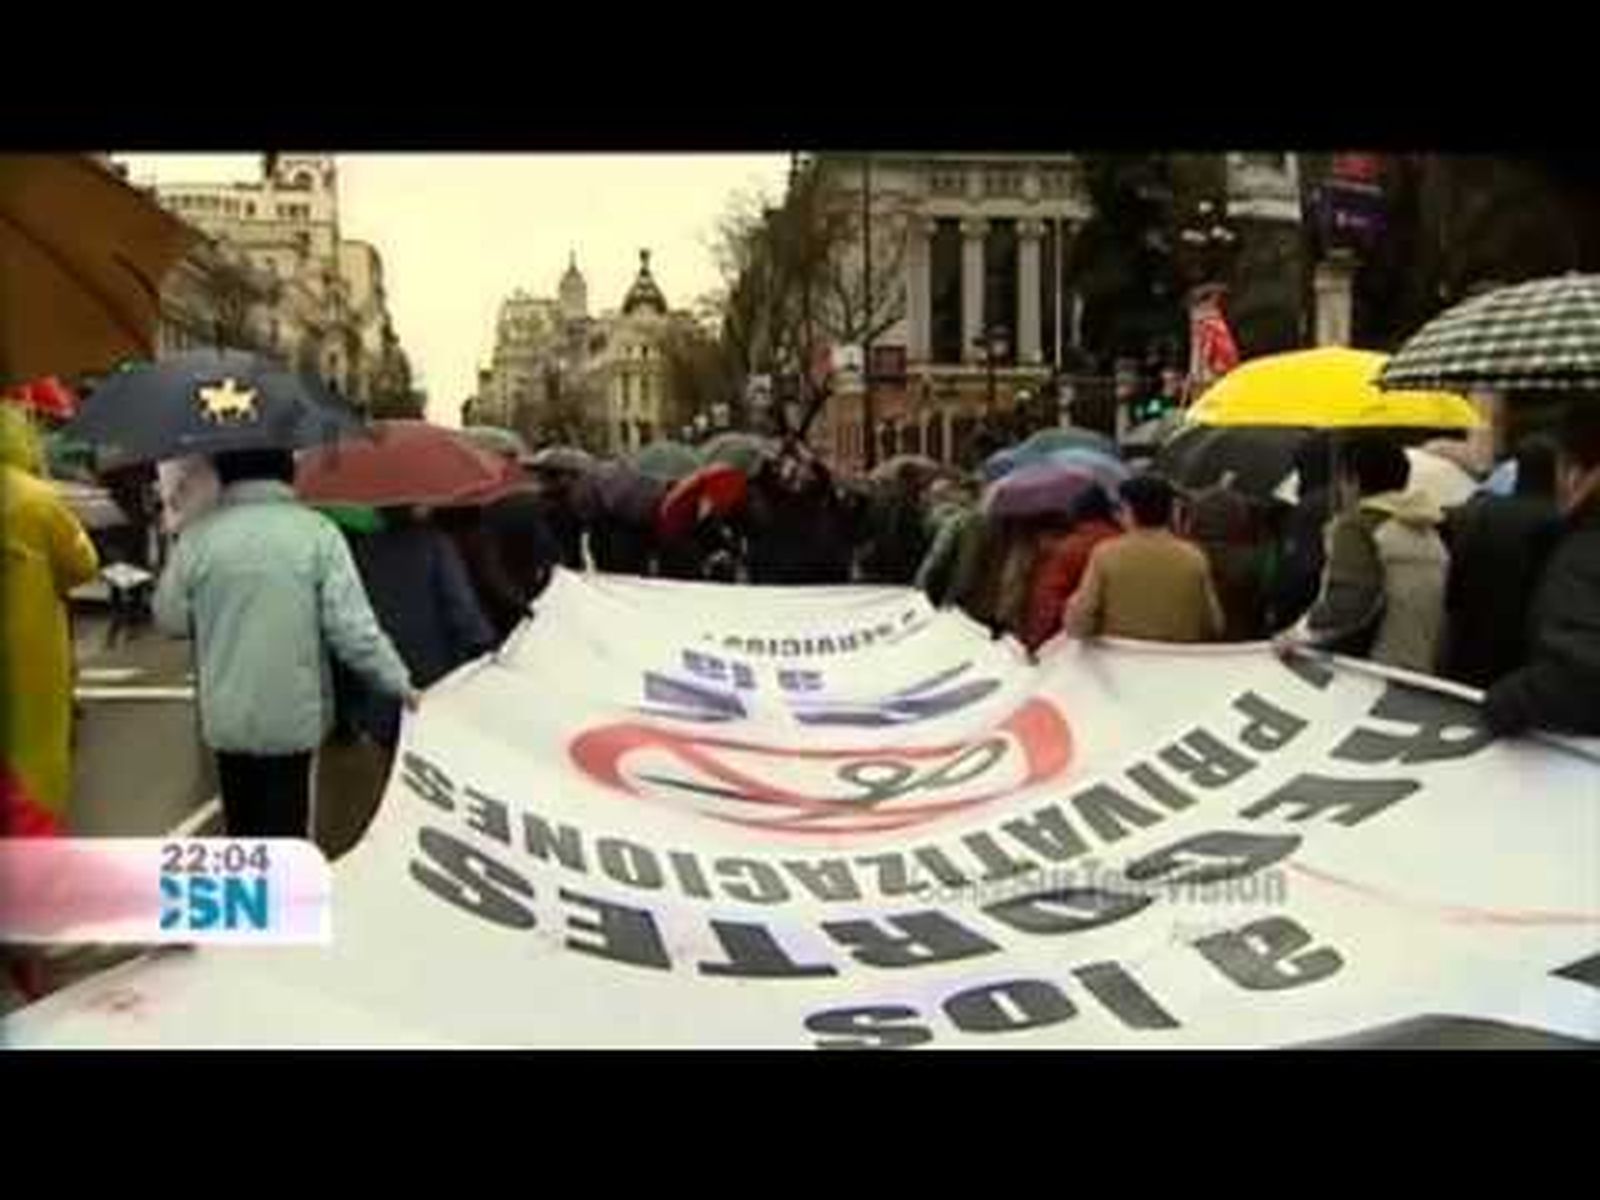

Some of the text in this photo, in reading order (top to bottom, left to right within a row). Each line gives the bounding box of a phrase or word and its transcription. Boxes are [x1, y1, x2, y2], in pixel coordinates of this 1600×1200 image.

[402, 691, 1309, 905] PRIVATIZACIONES
[1195, 915, 1346, 991] a
[804, 961, 1181, 1049] los
